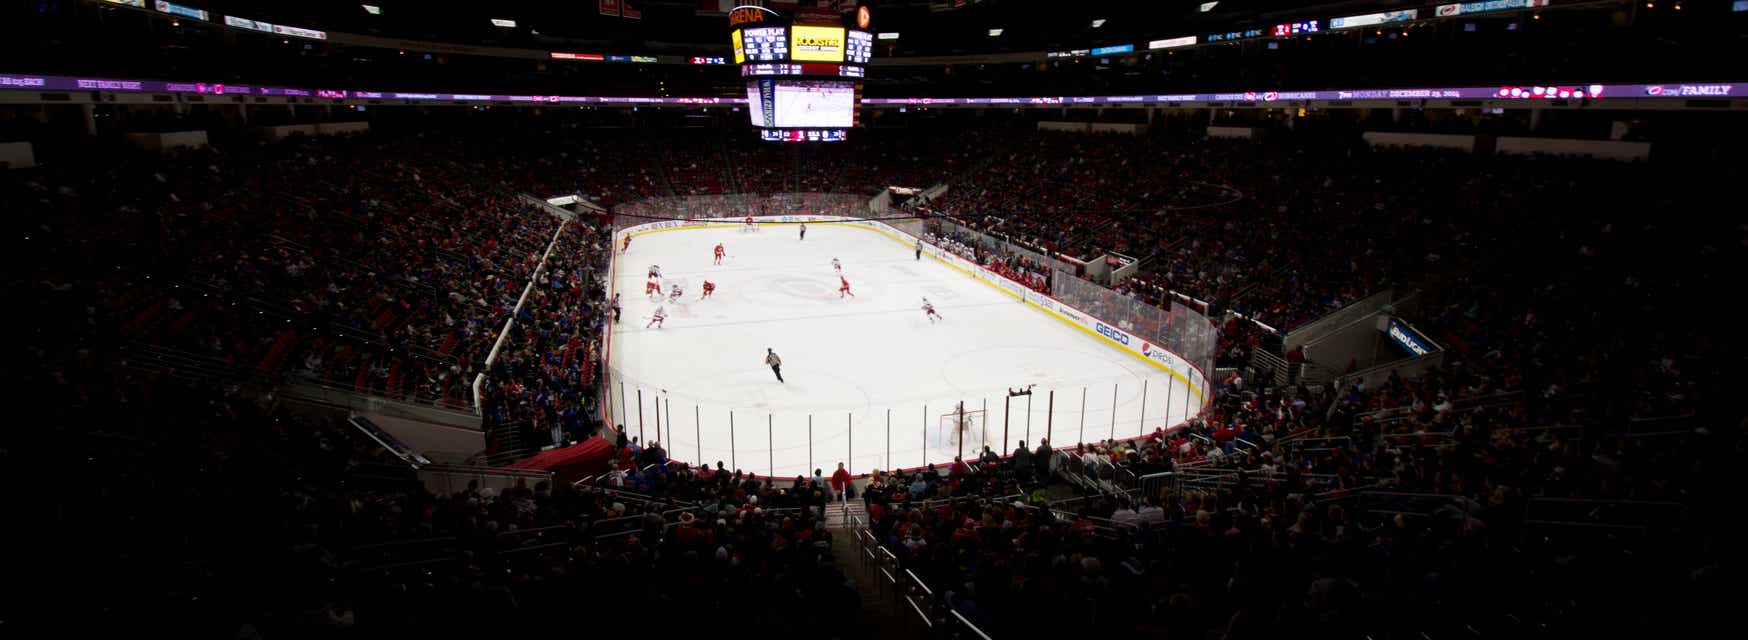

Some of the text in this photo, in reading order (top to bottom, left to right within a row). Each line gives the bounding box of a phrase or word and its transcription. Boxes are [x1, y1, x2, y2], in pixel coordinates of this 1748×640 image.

[730, 9, 764, 25] ARENA
[767, 28, 785, 36] PLAY
[1353, 90, 1388, 98] MONDAY
[1390, 90, 1430, 98] DECEMBER
[1096, 322, 1129, 345] GEICO
